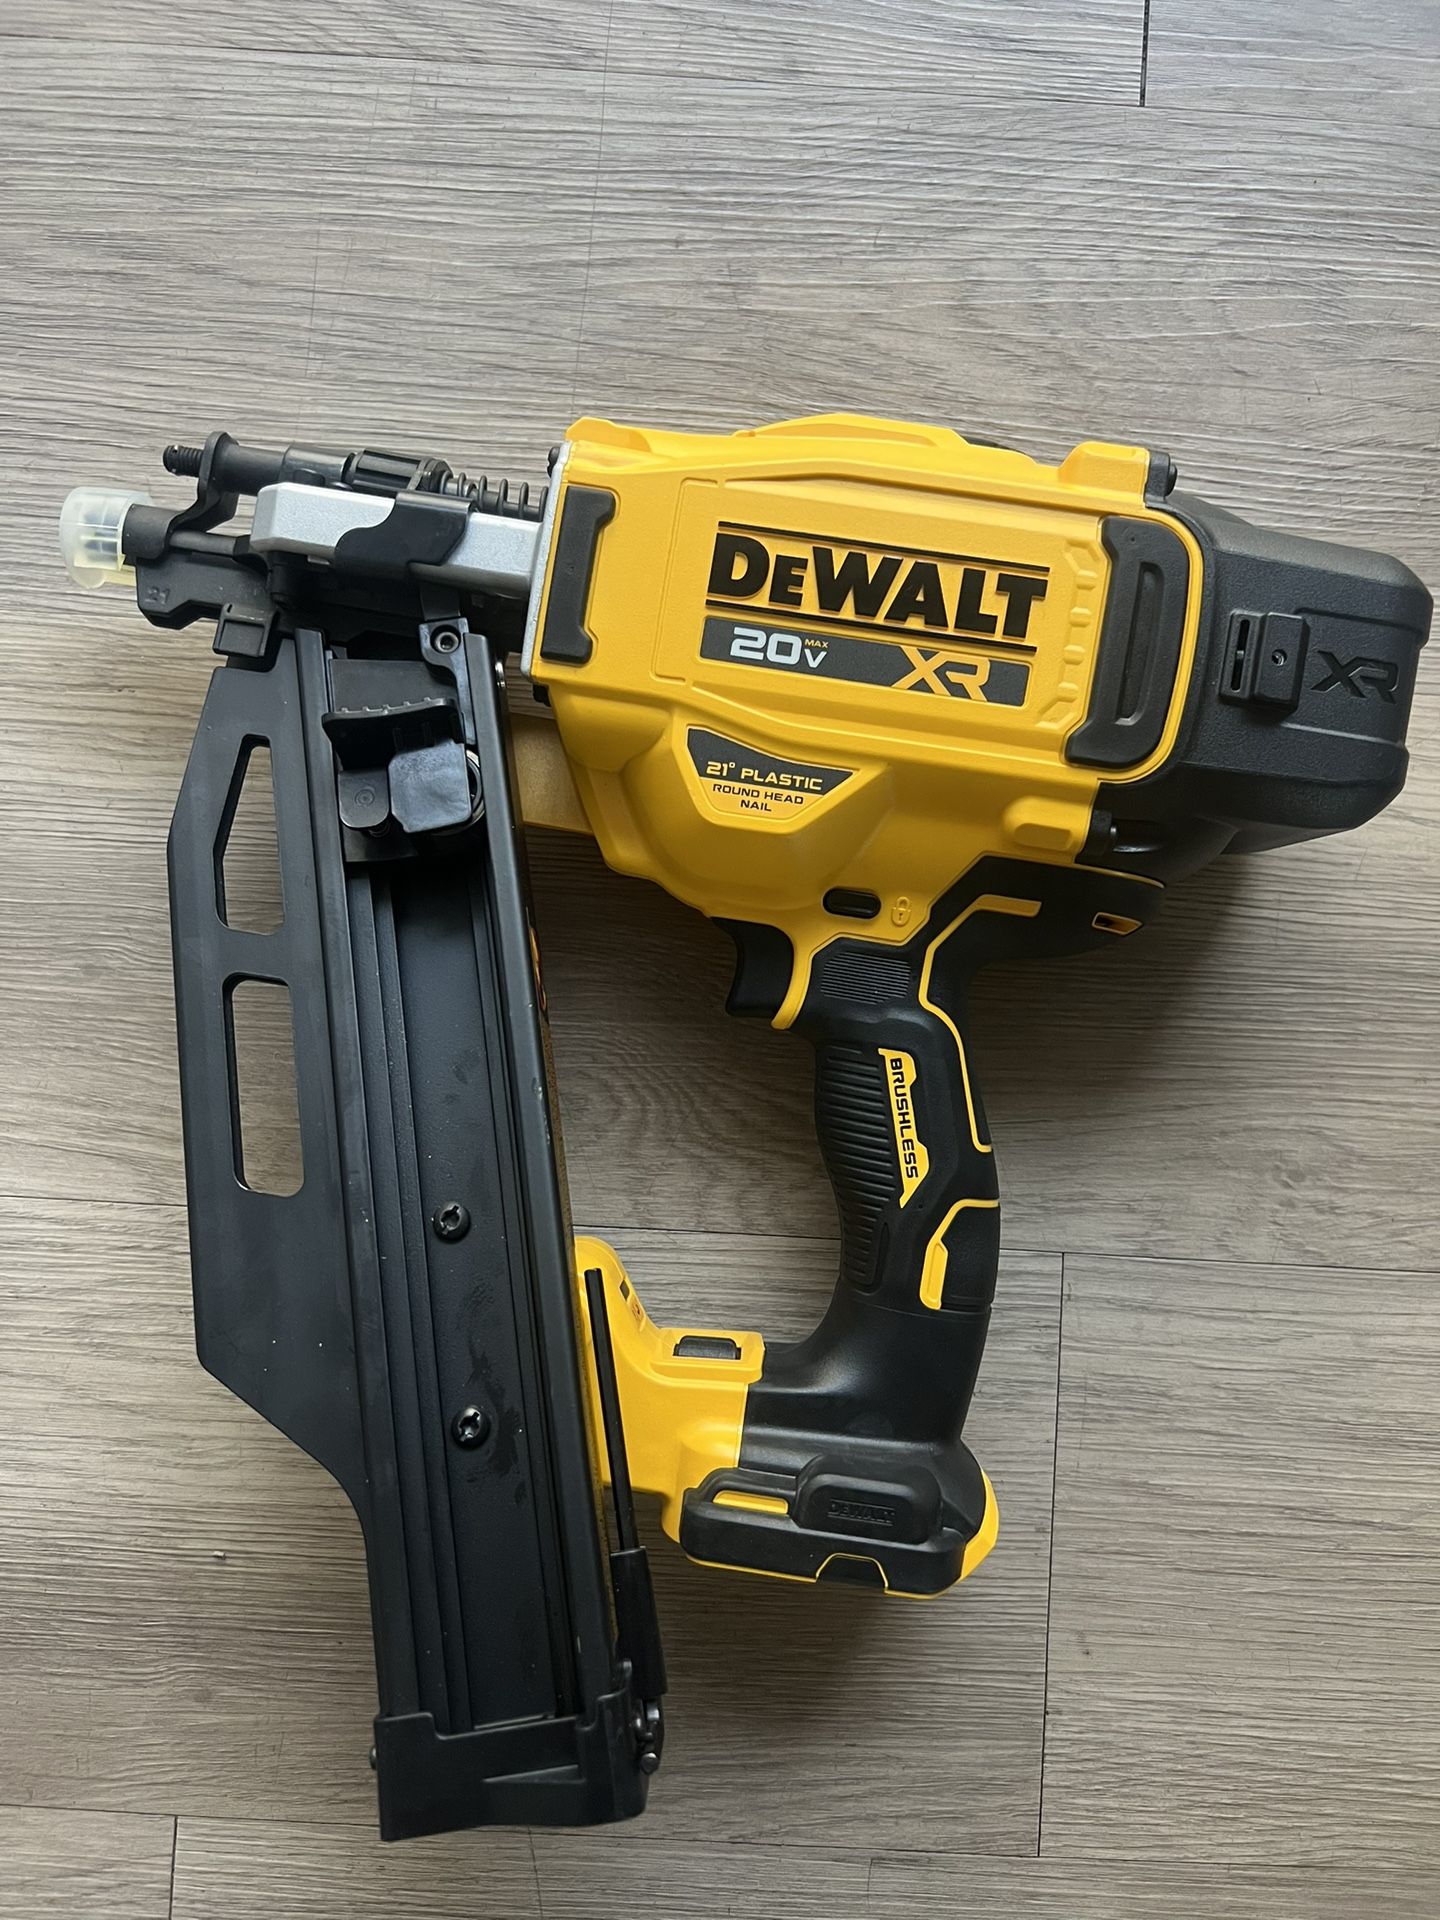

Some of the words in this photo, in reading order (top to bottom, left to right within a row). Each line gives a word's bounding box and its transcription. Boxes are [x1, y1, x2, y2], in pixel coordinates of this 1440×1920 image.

[804, 638, 829, 649] MAX
[890, 644, 990, 702] XR
[1311, 650, 1399, 703] XR
[740, 767, 824, 791] PLASTIC
[712, 783, 760, 798] ROUND
[764, 791, 804, 805] HEAD
[740, 799, 772, 812] NAIL
[889, 1057, 919, 1179] BRUSHLESS
